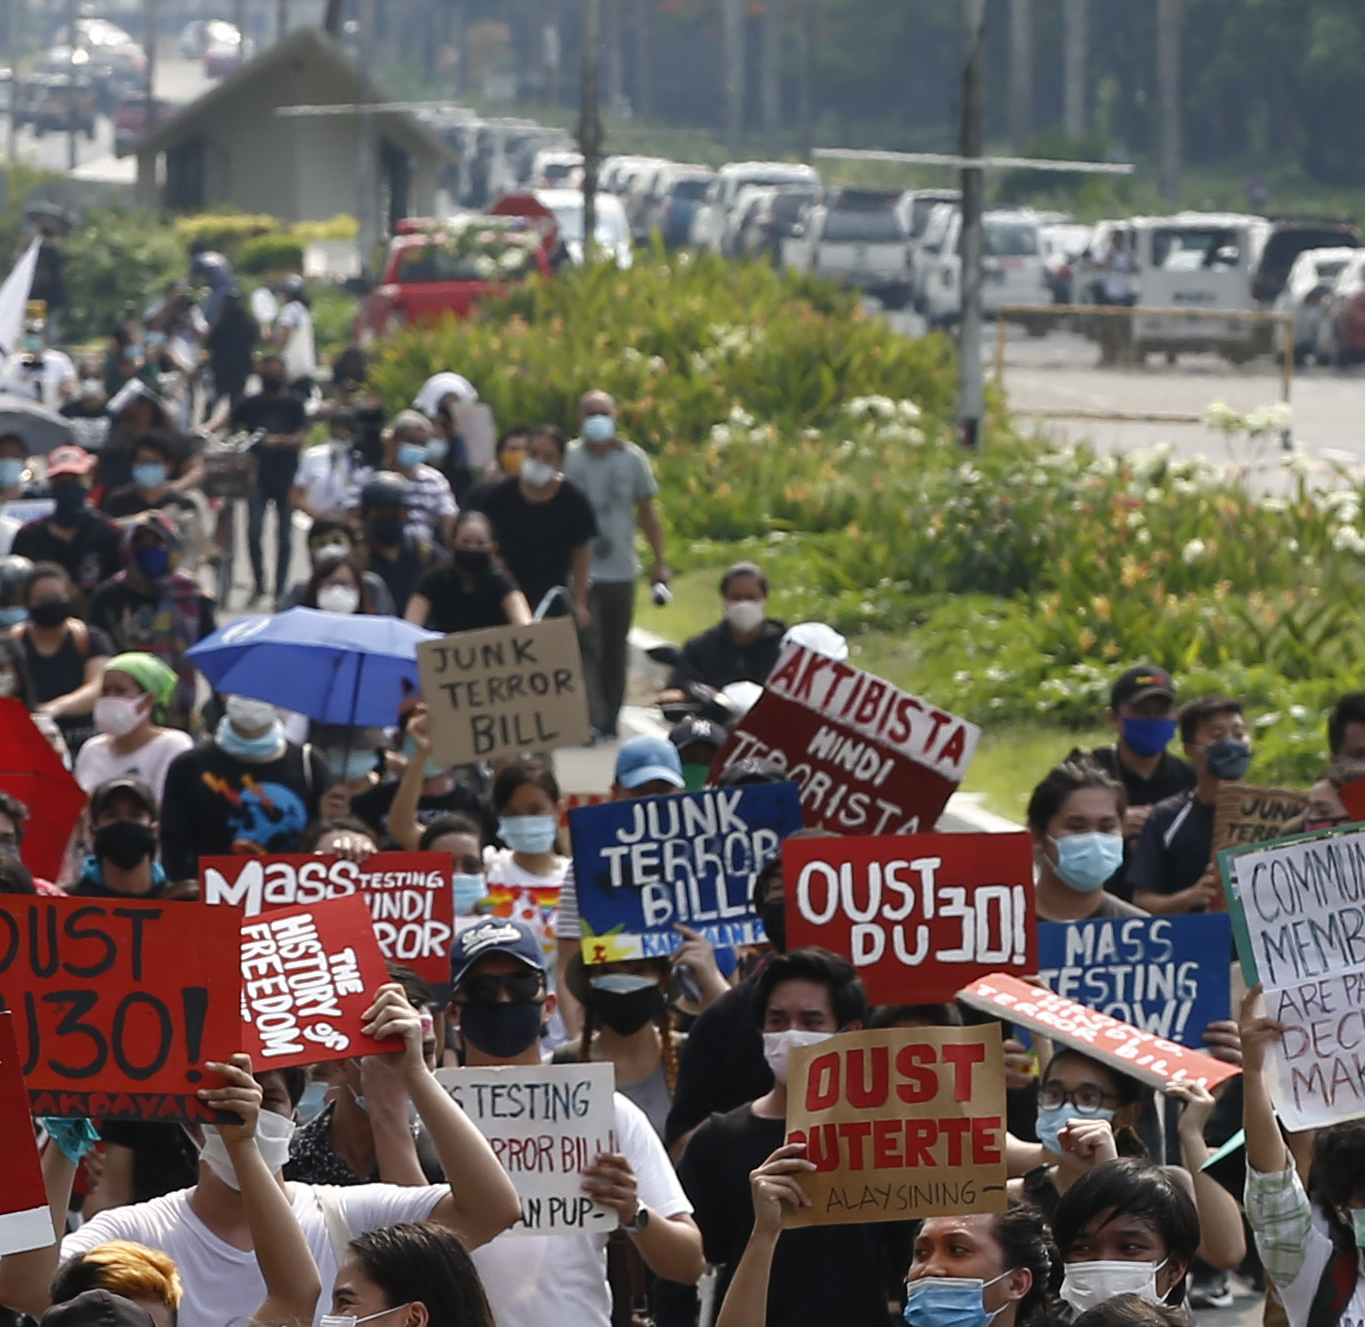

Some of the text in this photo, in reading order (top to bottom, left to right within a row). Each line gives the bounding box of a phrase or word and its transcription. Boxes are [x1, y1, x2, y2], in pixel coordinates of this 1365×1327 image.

[433, 637, 539, 674] JUNK
[439, 667, 575, 709] TERROR
[769, 645, 967, 769] AKTIBISTA
[470, 710, 560, 757] BILL
[806, 724, 896, 788] HINDI
[616, 788, 749, 844] JUNK
[1226, 822, 1287, 841] TERR
[359, 869, 445, 890] TESTING
[599, 828, 780, 888] TERROR
[640, 870, 757, 928] BILL!
[796, 856, 942, 926] OUST
[271, 912, 343, 1018] HISTORY
[1064, 919, 1173, 968] MASS
[240, 922, 305, 1057] FREEDOM
[328, 946, 365, 997] THE
[1037, 961, 1200, 1005] TESTING
[1097, 999, 1194, 1042] OW!
[1276, 984, 1336, 1024] ARE
[976, 983, 1210, 1088] TERROR BILL!
[470, 1080, 592, 1124] TESTING
[805, 1042, 986, 1113] OUST
[488, 1129, 615, 1174] RROR BIL
